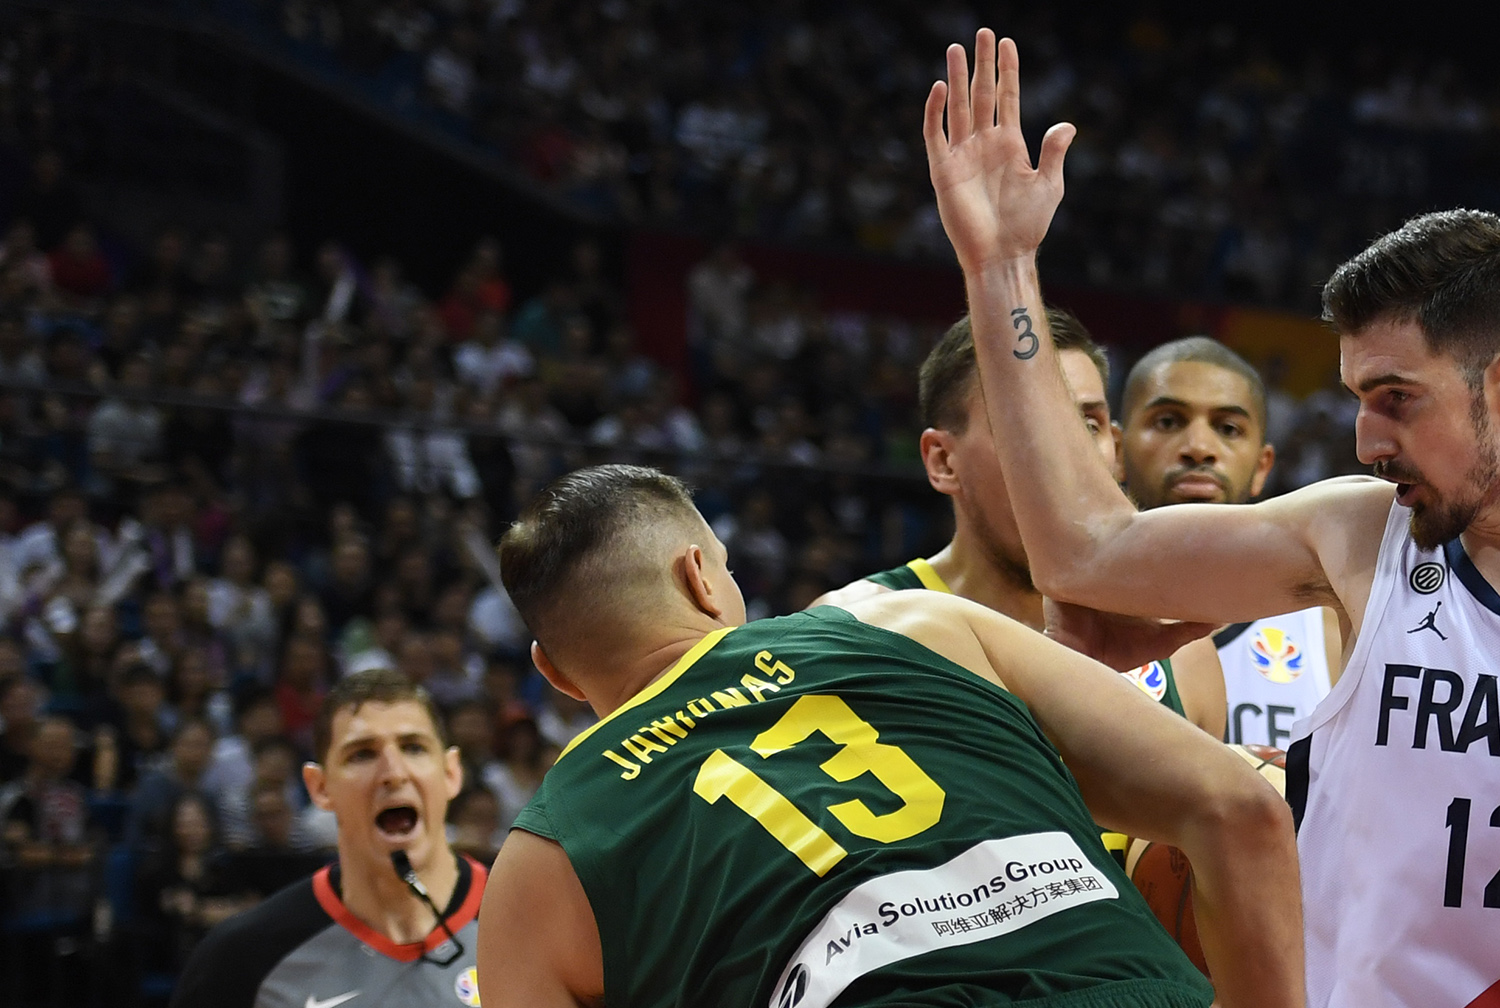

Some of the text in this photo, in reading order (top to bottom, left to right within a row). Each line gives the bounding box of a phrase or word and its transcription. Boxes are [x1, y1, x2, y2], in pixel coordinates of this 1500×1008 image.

[1224, 702, 1296, 747] CE
[693, 695, 946, 878] 13
[931, 876, 1103, 937] 阿维亚解决方案集团
